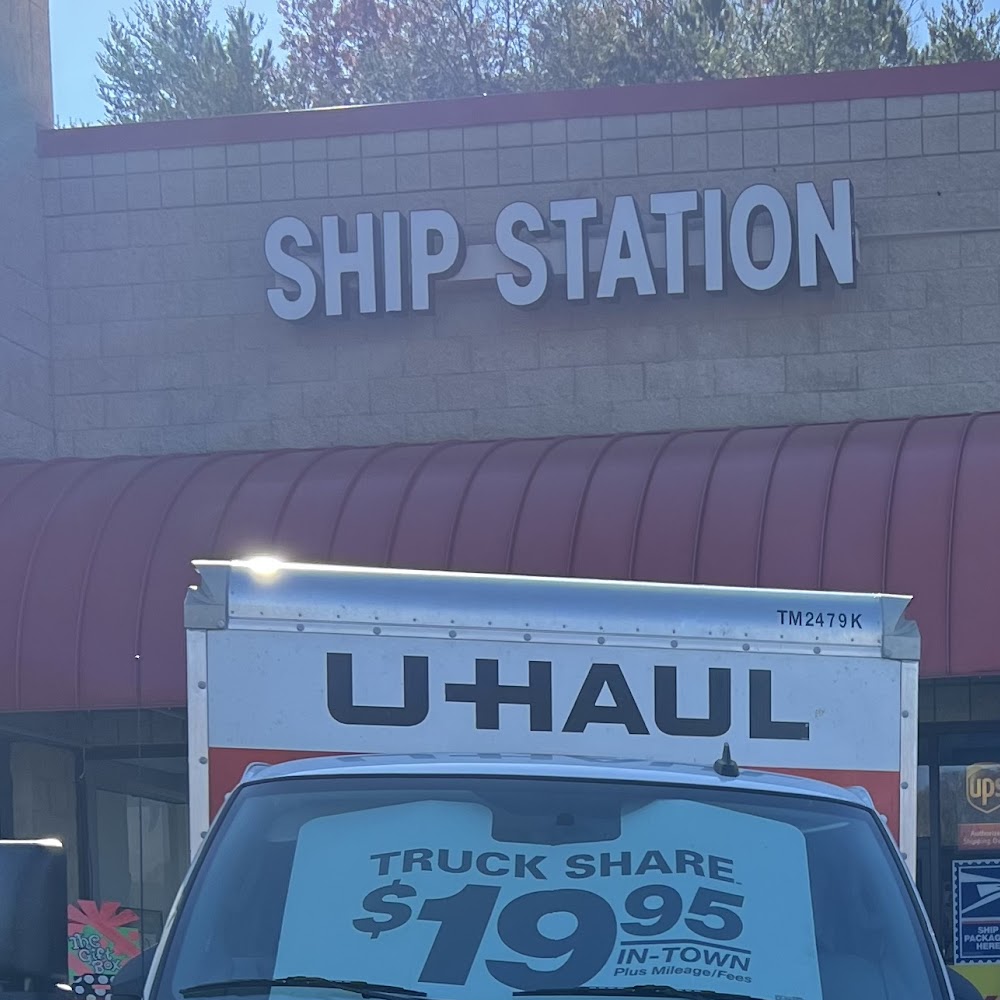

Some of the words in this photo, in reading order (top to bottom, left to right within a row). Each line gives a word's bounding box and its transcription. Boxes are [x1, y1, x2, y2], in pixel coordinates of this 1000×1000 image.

[264, 208, 464, 321] SHIP
[495, 178, 855, 307] STATION
[776, 609, 863, 630] TM2479K
[370, 848, 547, 879] TRUCK
[565, 848, 735, 884] SHARE
[977, 926, 999, 934] SHIP
[976, 942, 1000, 950] HERE
[616, 946, 752, 972] IN-TOWN
[613, 967, 647, 977] Plus
[651, 965, 753, 983] Mileage/Fees
